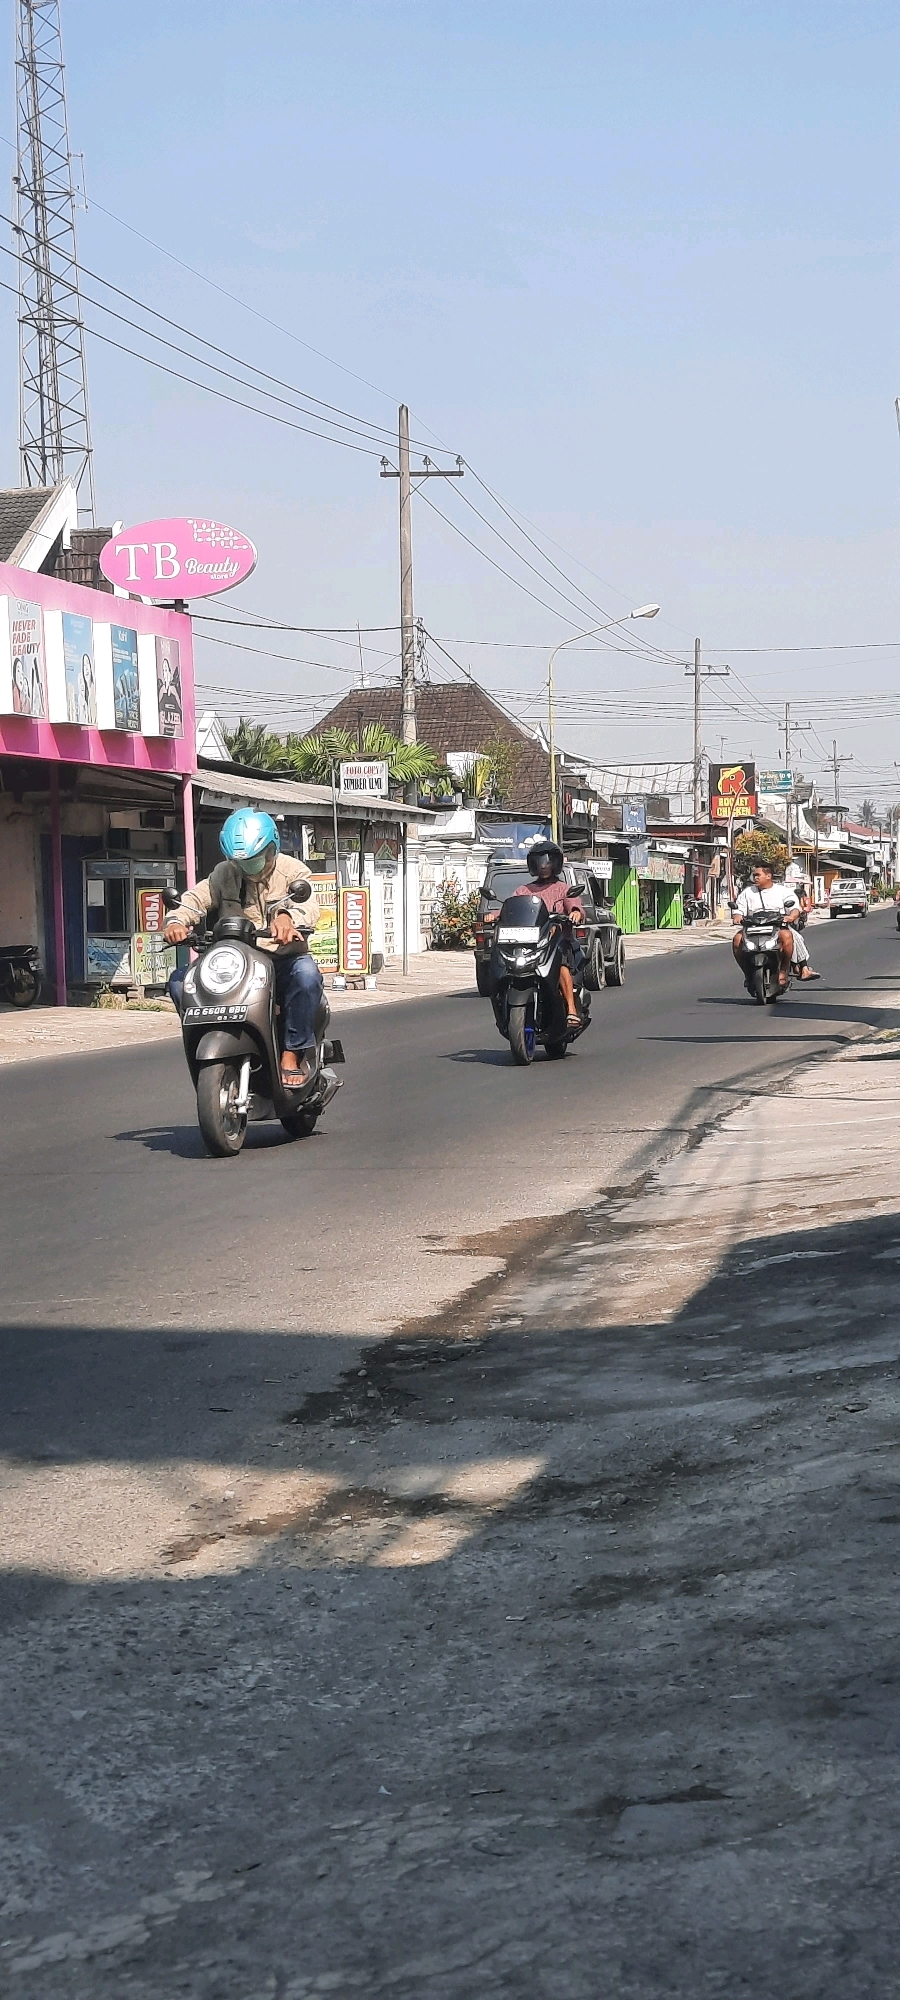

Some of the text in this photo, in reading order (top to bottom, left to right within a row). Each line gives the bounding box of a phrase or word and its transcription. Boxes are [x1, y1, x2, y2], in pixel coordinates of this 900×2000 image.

[115, 542, 240, 581] TB Beauty
[12, 620, 36, 632] NEVER
[12, 632, 31, 644] FADE
[12, 642, 41, 656] BEAUTY
[346, 891, 363, 970] POTO COPY
[188, 1008, 201, 1016] AG
